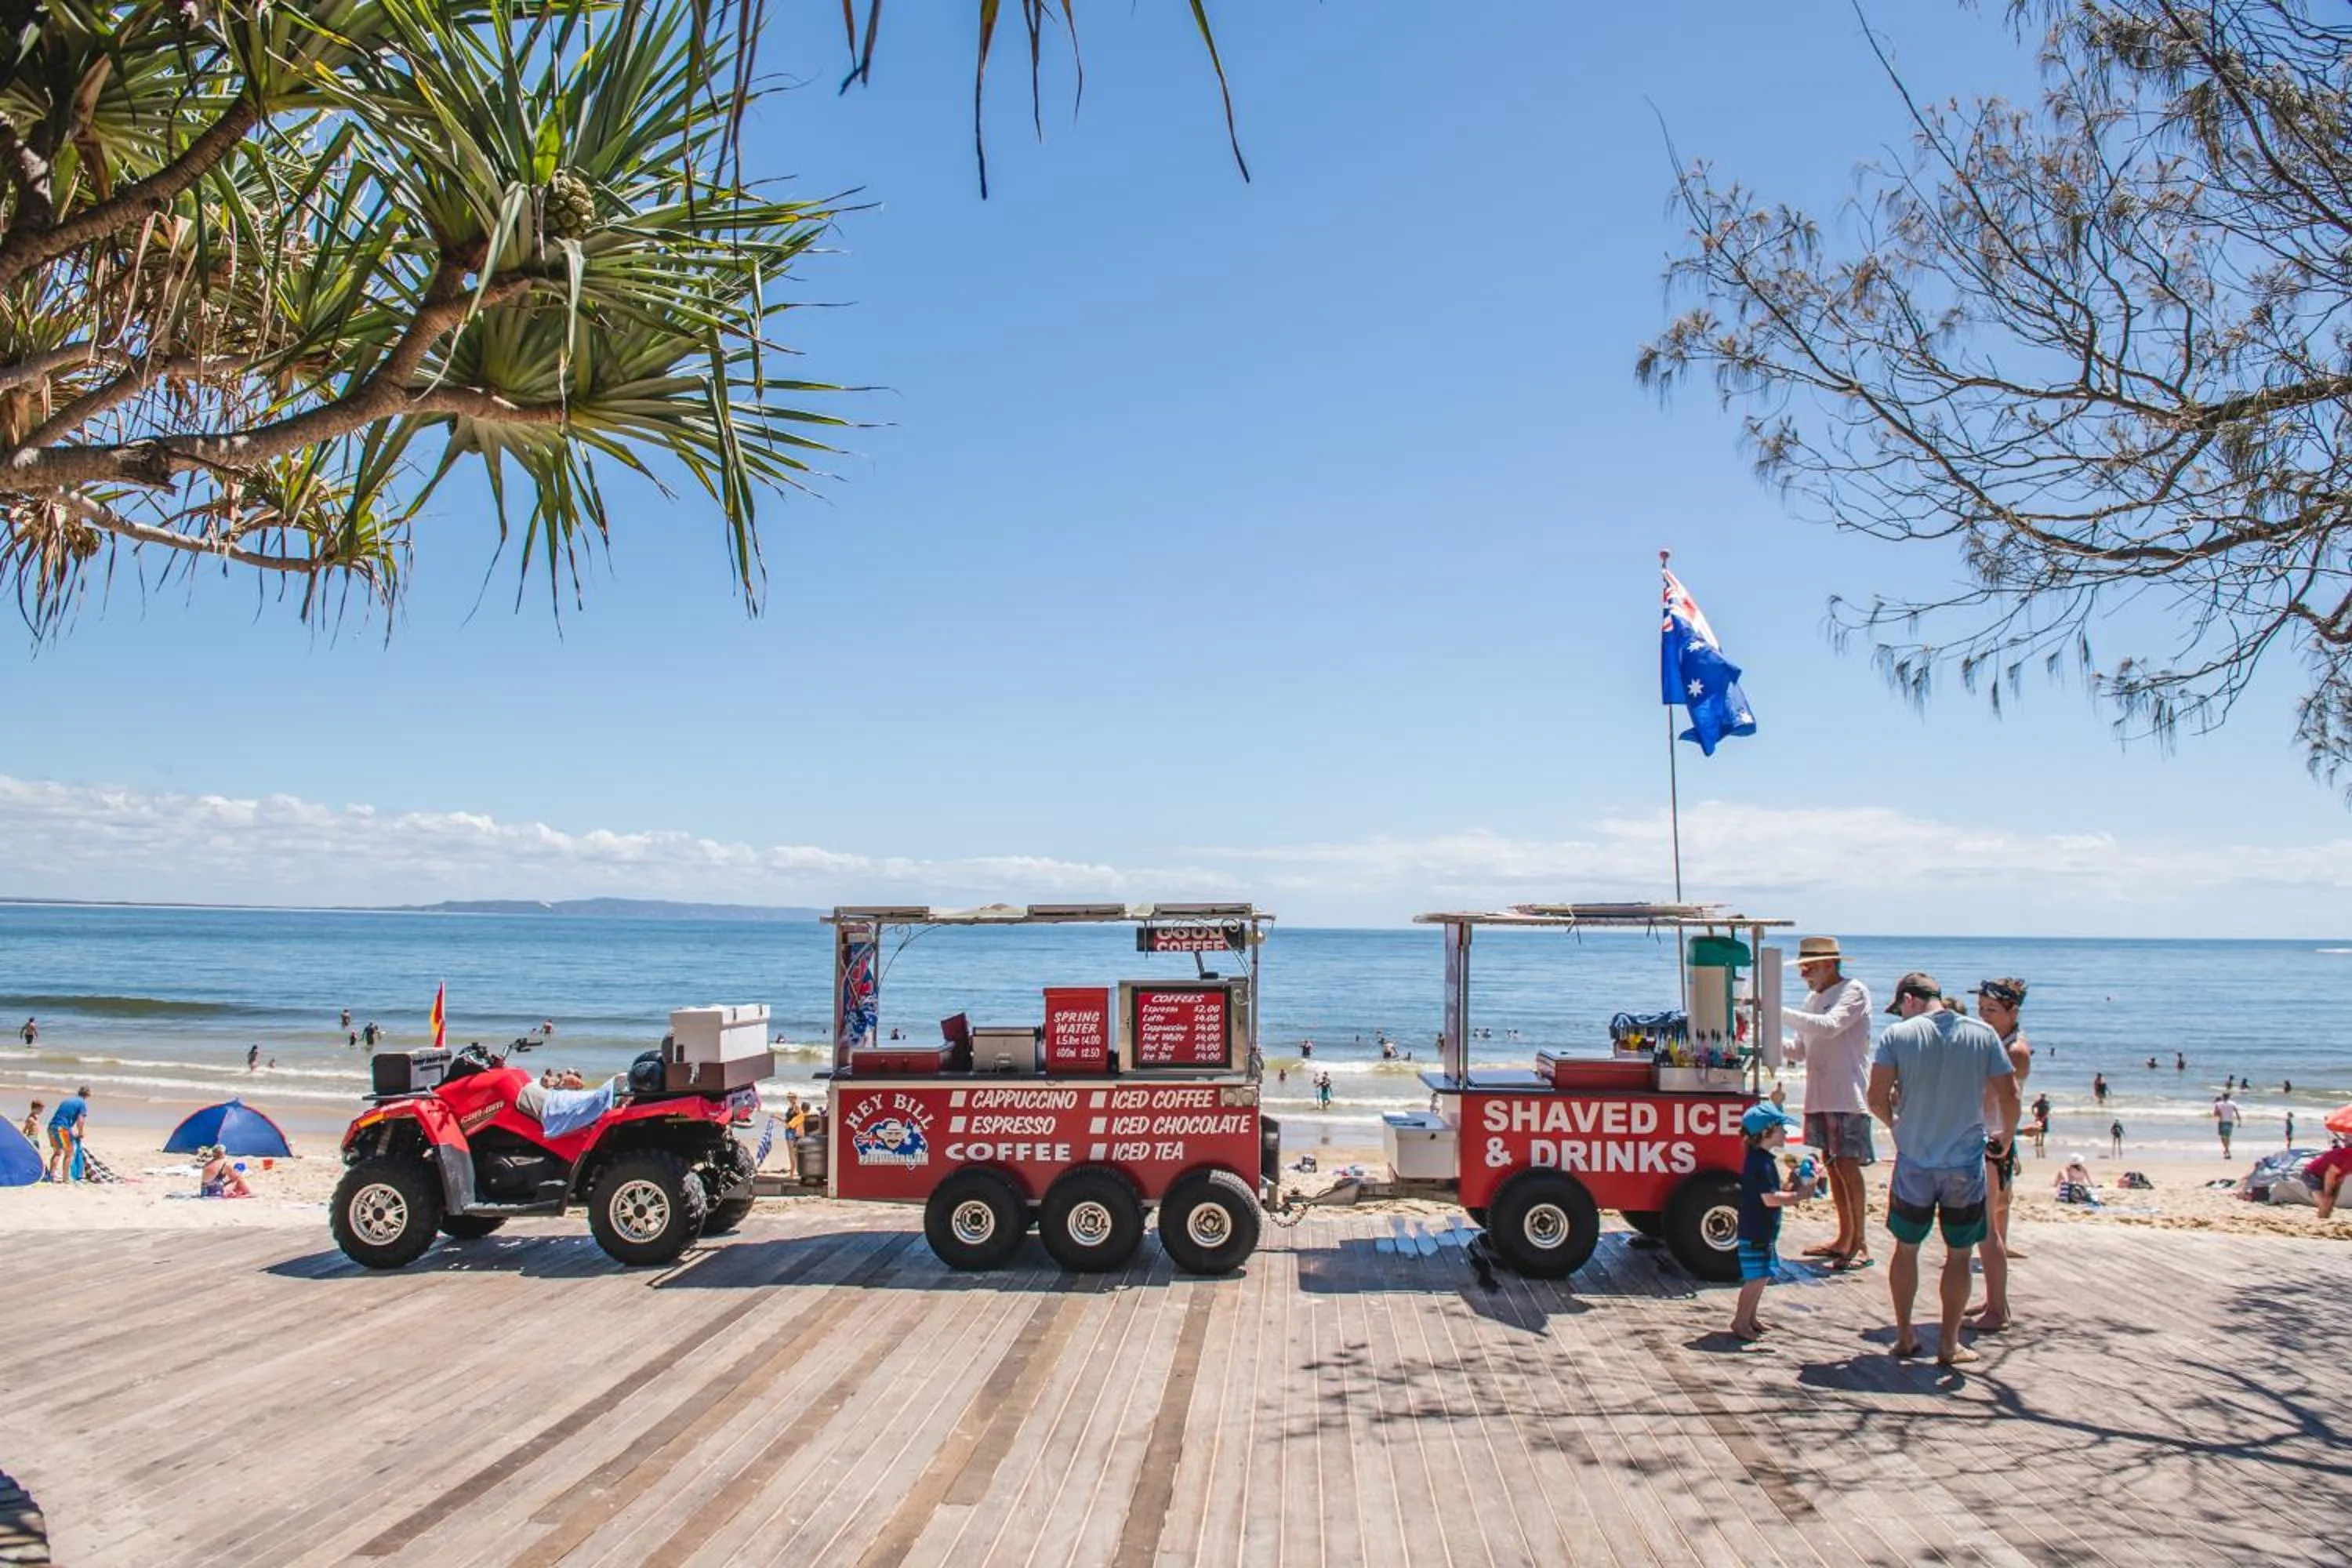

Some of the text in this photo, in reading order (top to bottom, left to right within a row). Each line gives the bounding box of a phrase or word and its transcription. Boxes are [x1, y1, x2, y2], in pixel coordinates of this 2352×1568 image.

[1156, 941, 1224, 951] COFFEE
[1152, 994, 1204, 1003] COFFEES
[1054, 1011, 1100, 1022] SPRING
[1056, 1023, 1098, 1034] WATER
[971, 1091, 1079, 1109] CAPPUCCINO
[1111, 1089, 1214, 1109] ICED COFFEE
[844, 1093, 935, 1131] HEY BILL
[1483, 1100, 1744, 1136] SHAVED ICE
[971, 1116, 1056, 1135] ESPRESSO
[1112, 1114, 1251, 1135] ICED CHOCOLATE
[945, 1142, 1072, 1161] COFFEE
[1112, 1141, 1184, 1161] ICED TEA
[1485, 1136, 1696, 1174] & DRINKS
